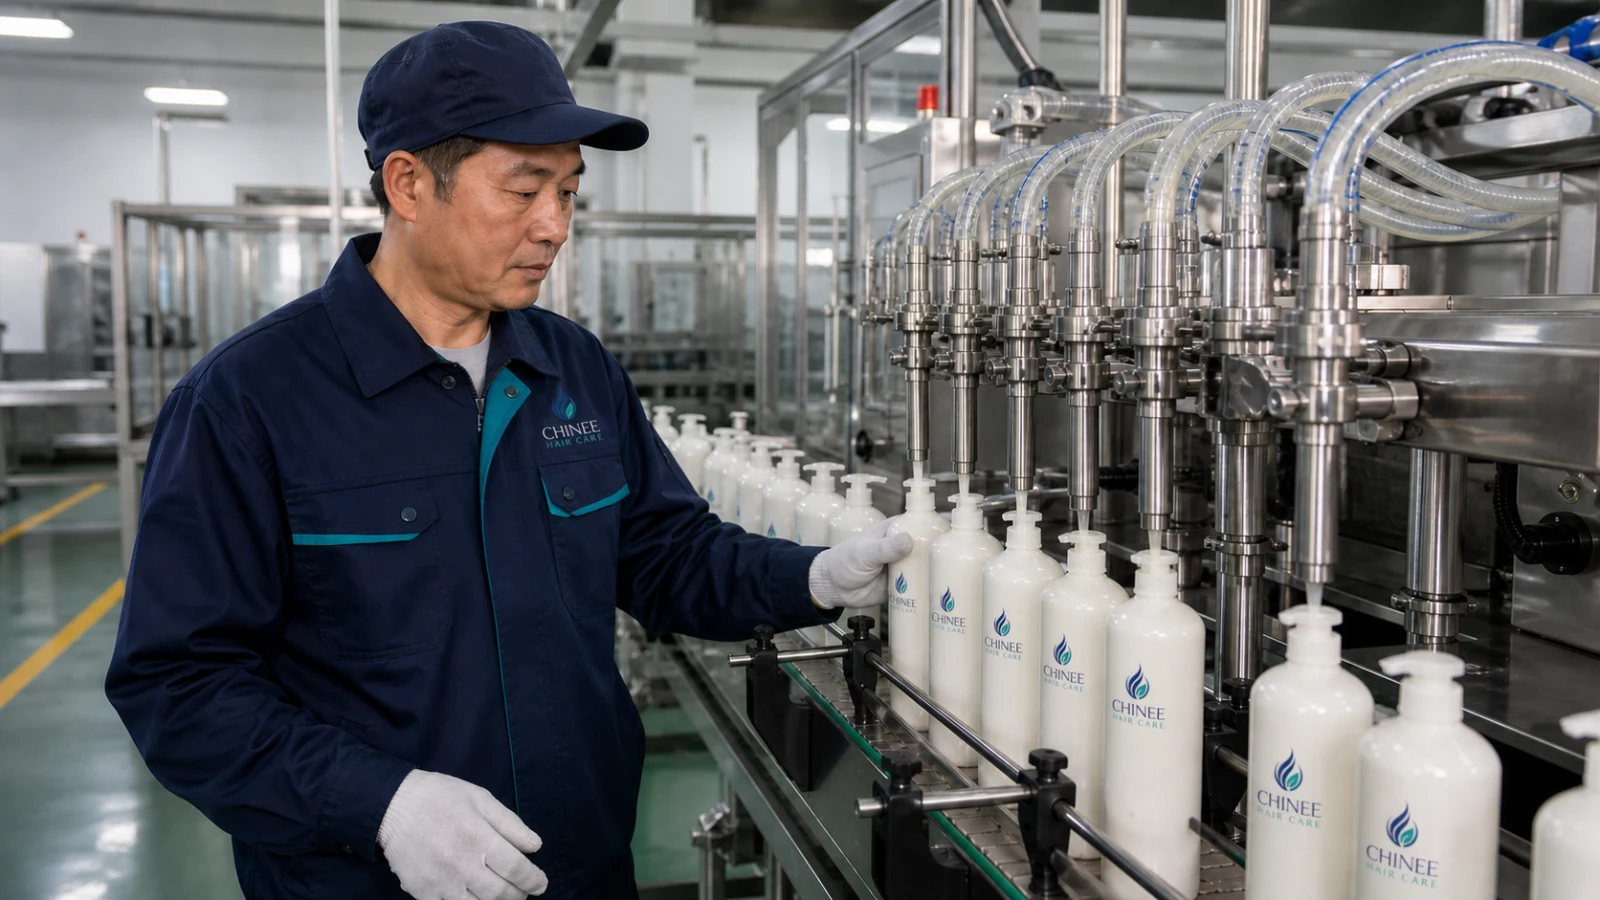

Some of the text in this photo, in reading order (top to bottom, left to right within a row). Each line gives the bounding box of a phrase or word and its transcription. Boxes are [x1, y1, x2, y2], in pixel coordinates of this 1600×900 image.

[542, 420, 601, 440] CHINEE
[546, 433, 604, 449] HAIR CARE
[931, 611, 966, 628] CHINEE
[984, 636, 1022, 653] CHINEE
[1003, 651, 1022, 661] CARE
[1043, 665, 1085, 684] CHINEE
[1062, 682, 1085, 692] CARE
[1112, 699, 1166, 720] CHINEE
[1112, 713, 1165, 729] HAIR CARE
[1257, 789, 1322, 818] CHINEE
[1257, 806, 1320, 829] HAIR CARE
[1366, 844, 1440, 877] CHINEE
[1366, 862, 1437, 889] HAIR CARE
